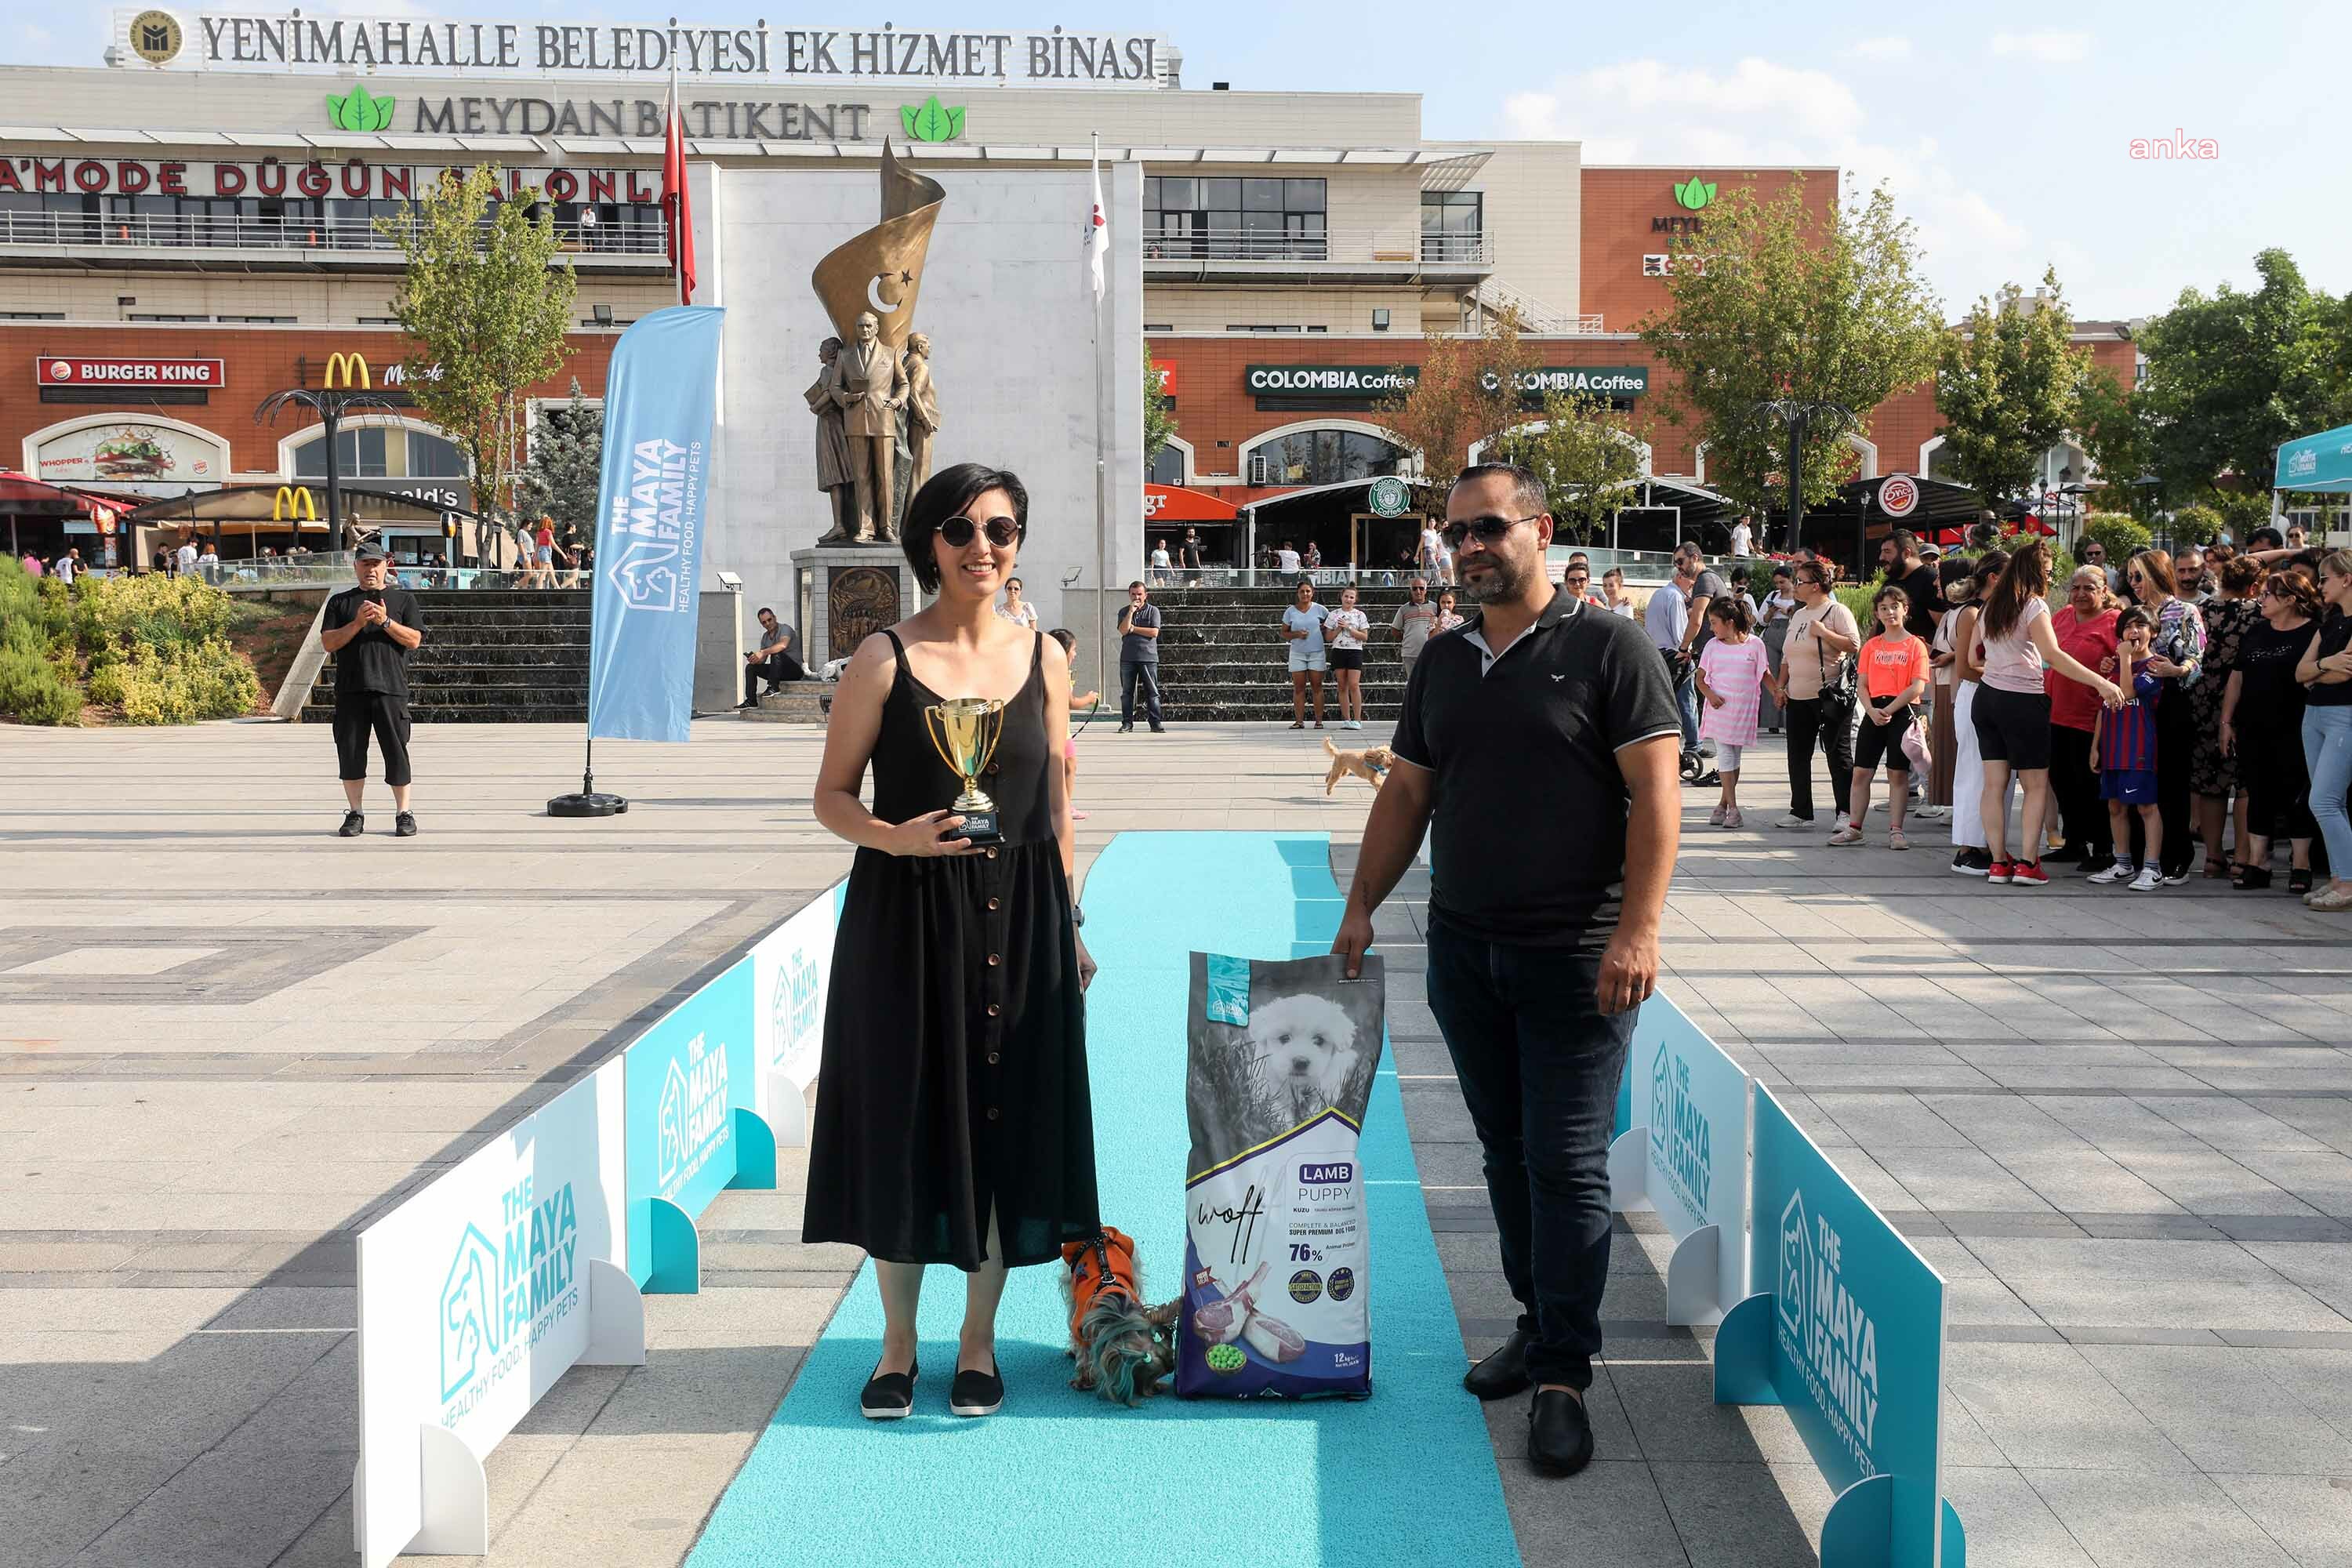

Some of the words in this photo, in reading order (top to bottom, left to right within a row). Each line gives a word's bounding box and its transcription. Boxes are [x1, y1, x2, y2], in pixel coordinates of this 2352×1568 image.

[200, 8, 521, 68] YENİMAHALLE
[535, 17, 770, 74] BELEDİYESİ
[785, 31, 844, 74] EK
[848, 21, 1012, 78] HİZMET
[1027, 24, 1157, 80] BİNASI
[214, 155, 411, 199] DÜĞÜN
[81, 364, 158, 380] BURGER
[162, 365, 210, 381] KING
[1250, 370, 1360, 389] COLOMBIA
[1481, 372, 1589, 390] CLOMBIA
[1590, 376, 1644, 390] Coffee
[40, 457, 83, 468] WHOPPER
[689, 441, 702, 474] PETS
[611, 495, 629, 535] THE
[630, 438, 663, 539] MAYA
[658, 438, 687, 539] FAMILY
[684, 475, 699, 516] HAPPY
[1377, 507, 1402, 516] Coffee
[682, 517, 697, 556] FOOD,
[678, 559, 693, 613] HEALTHY
[792, 946, 802, 974] THE
[793, 959, 818, 1012] MAYA
[793, 991, 818, 1045] FAMILY
[688, 1030, 705, 1067] THE
[1675, 1053, 1690, 1094] THE
[689, 1041, 728, 1115] MAYA
[689, 1083, 728, 1156] FAMILY
[1675, 1085, 1711, 1172] MAYA
[1298, 1186, 1352, 1202] PUPPY
[1303, 1166, 1349, 1181] LAMB
[1675, 1132, 1711, 1214] FAMILY
[502, 1174, 533, 1226] THE
[1198, 1185, 1264, 1265] woff
[503, 1180, 577, 1291] MAYA
[1818, 1213, 1842, 1275] THE
[503, 1233, 577, 1345] FAMILY
[524, 1306, 556, 1352] HAPPY
[556, 1287, 579, 1324] PETS
[1816, 1257, 1878, 1396] MAYA
[1777, 1323, 1806, 1380] HEALTHY
[1828, 1399, 1855, 1456] HAPPY
[1814, 1318, 1878, 1451] FAMILY
